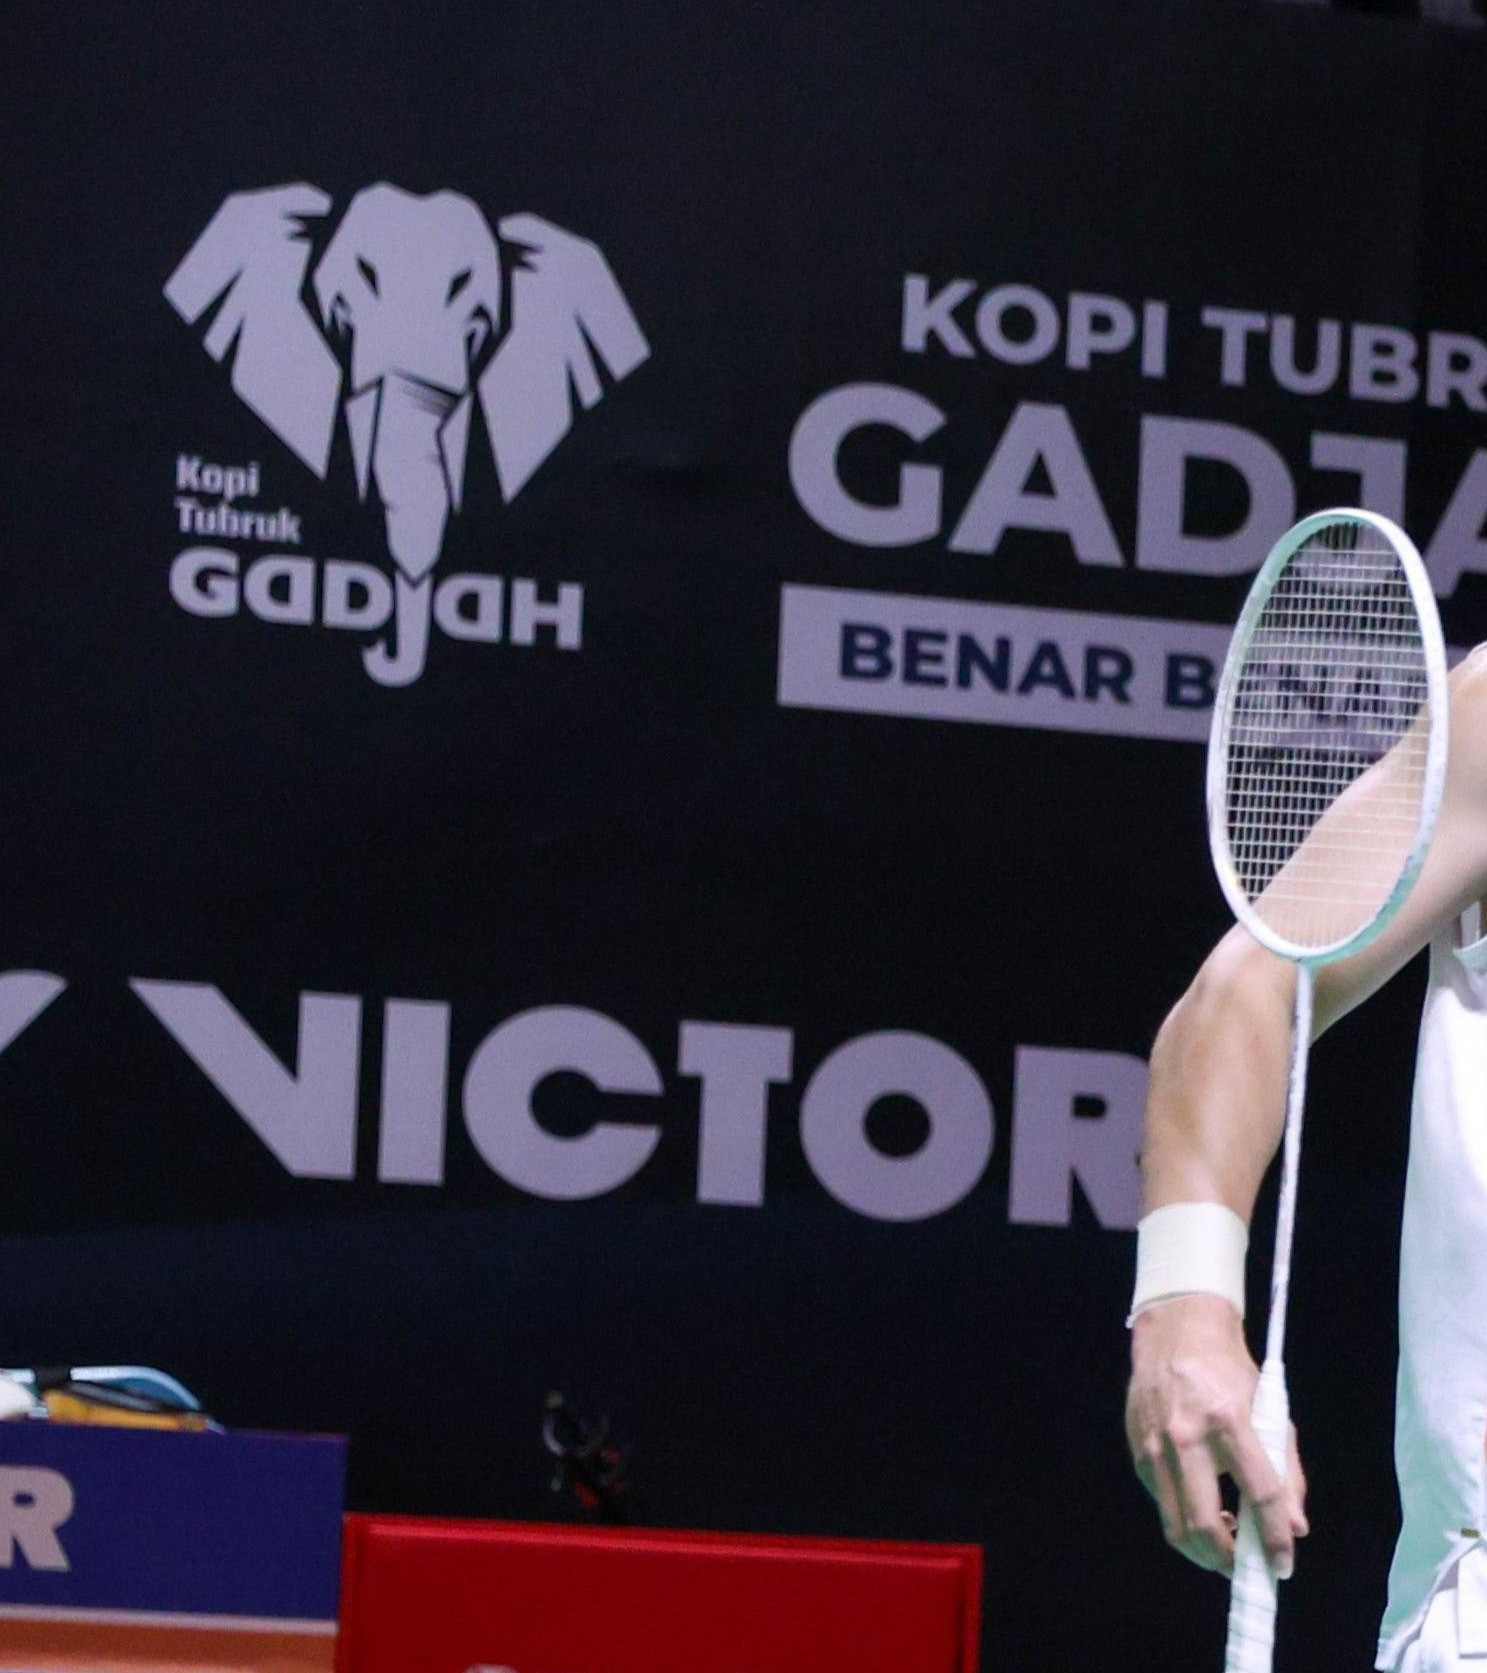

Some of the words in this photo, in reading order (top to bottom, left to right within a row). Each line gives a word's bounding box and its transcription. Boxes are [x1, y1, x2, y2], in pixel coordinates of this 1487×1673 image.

[901, 273, 1168, 378] KOPI
[175, 454, 260, 498] Kopi
[176, 499, 301, 545] Tubruk
[838, 623, 1133, 703] BENAR
[128, 976, 1150, 1231] VICTOR
